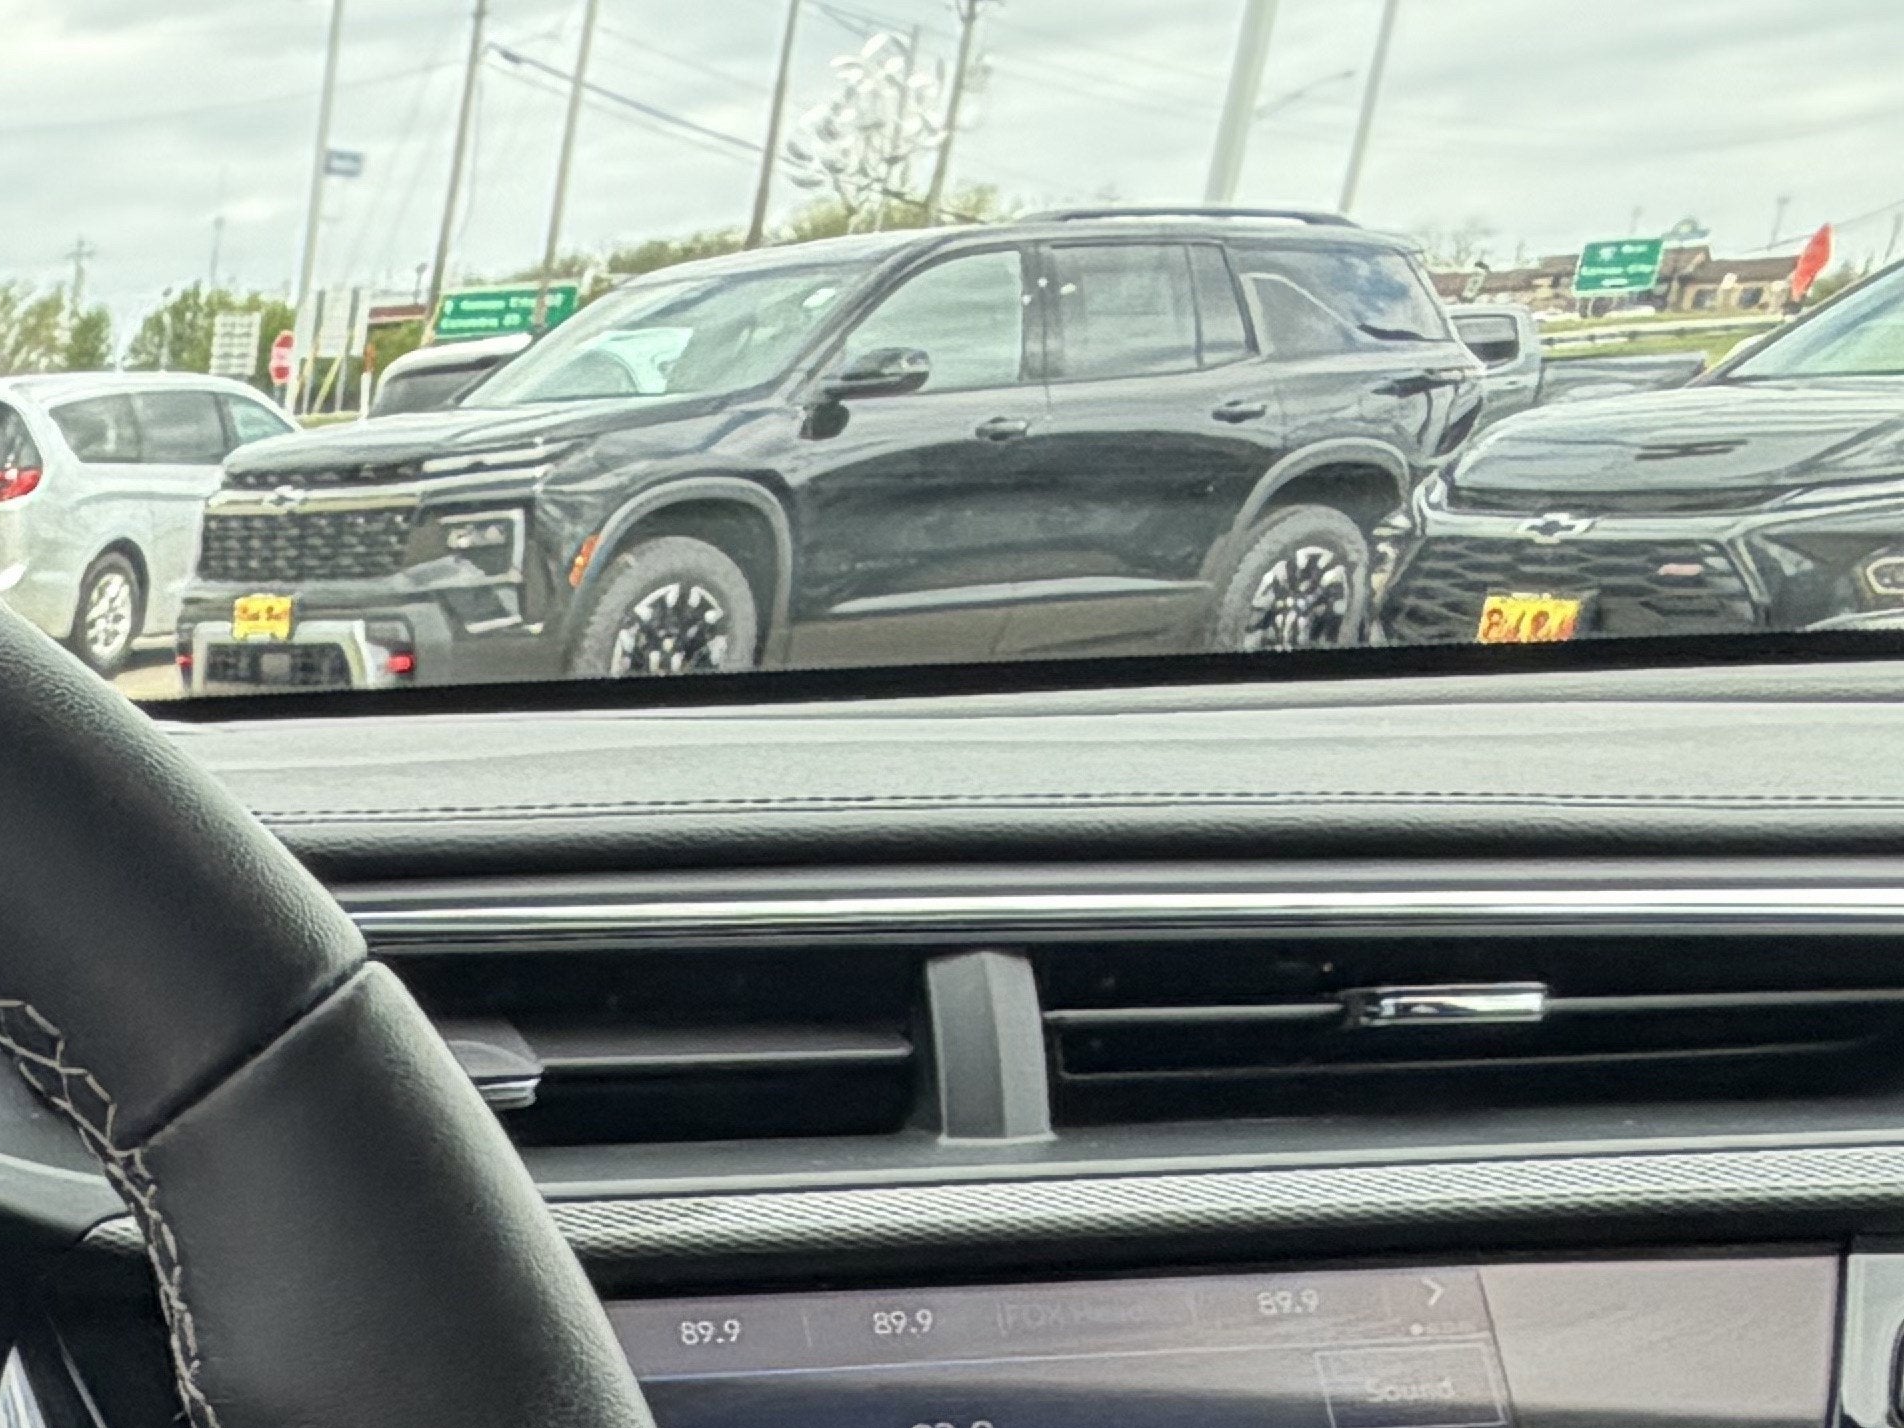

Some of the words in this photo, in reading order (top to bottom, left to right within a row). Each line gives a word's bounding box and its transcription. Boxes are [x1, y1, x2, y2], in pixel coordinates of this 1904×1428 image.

[1256, 1287, 1320, 1316] 89.9
[679, 1319, 743, 1345] 89.9
[872, 1308, 934, 1336] 89.9
